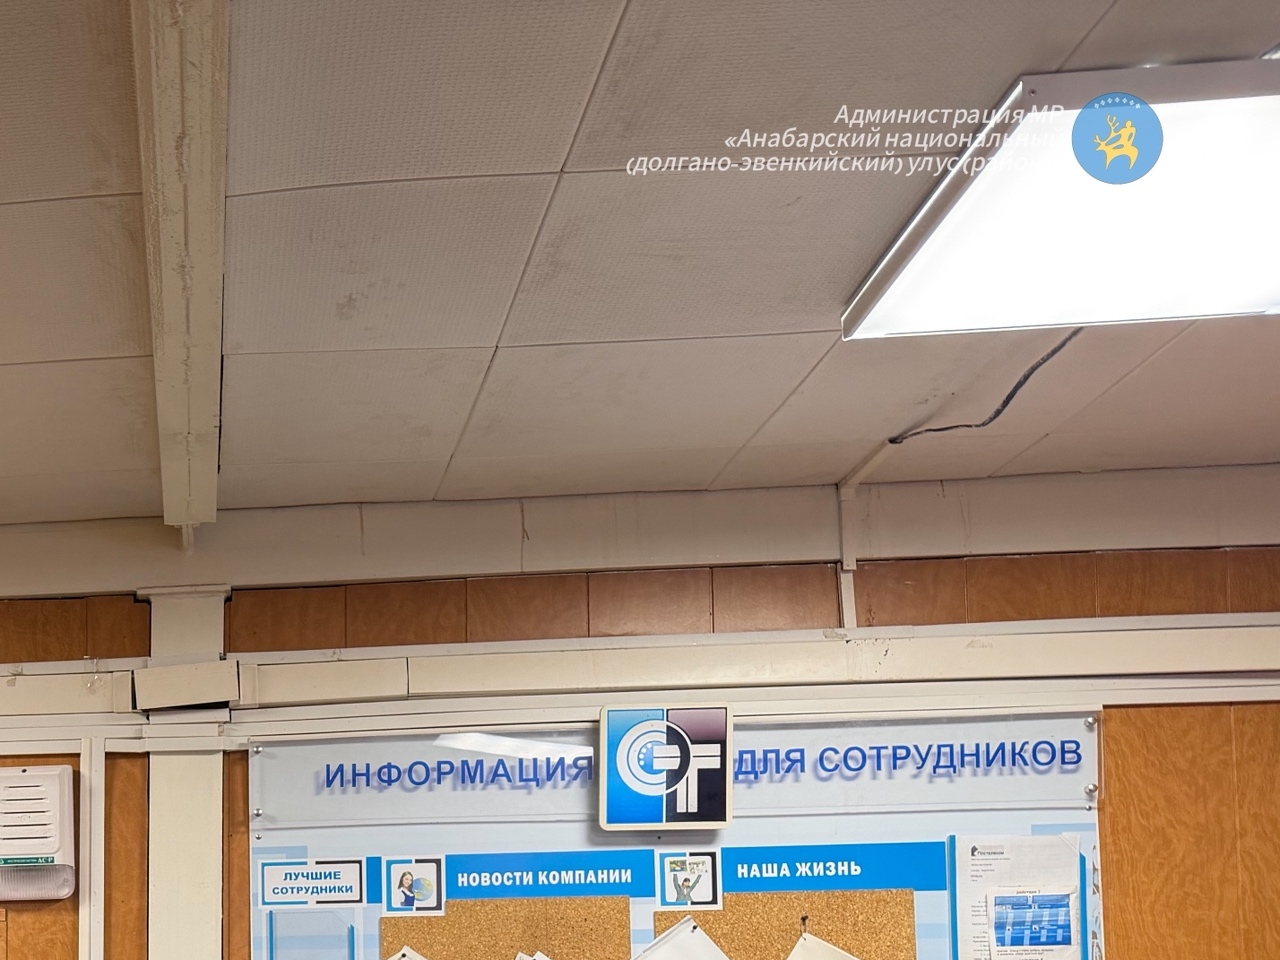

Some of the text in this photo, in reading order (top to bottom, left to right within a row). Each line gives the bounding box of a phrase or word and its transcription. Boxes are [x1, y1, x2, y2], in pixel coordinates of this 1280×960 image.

[324, 738, 1083, 789] ИНФОРМАЦИЯ ДЛЯ СОТРУДНИКОВ
[283, 870, 341, 882] ЛУЧШИЕ
[457, 868, 632, 887] НОВОСТИ КОМПАНИИ
[737, 859, 862, 879] НАША ЖИЗНЬ
[272, 883, 354, 897] СОТРУДНИКИ
